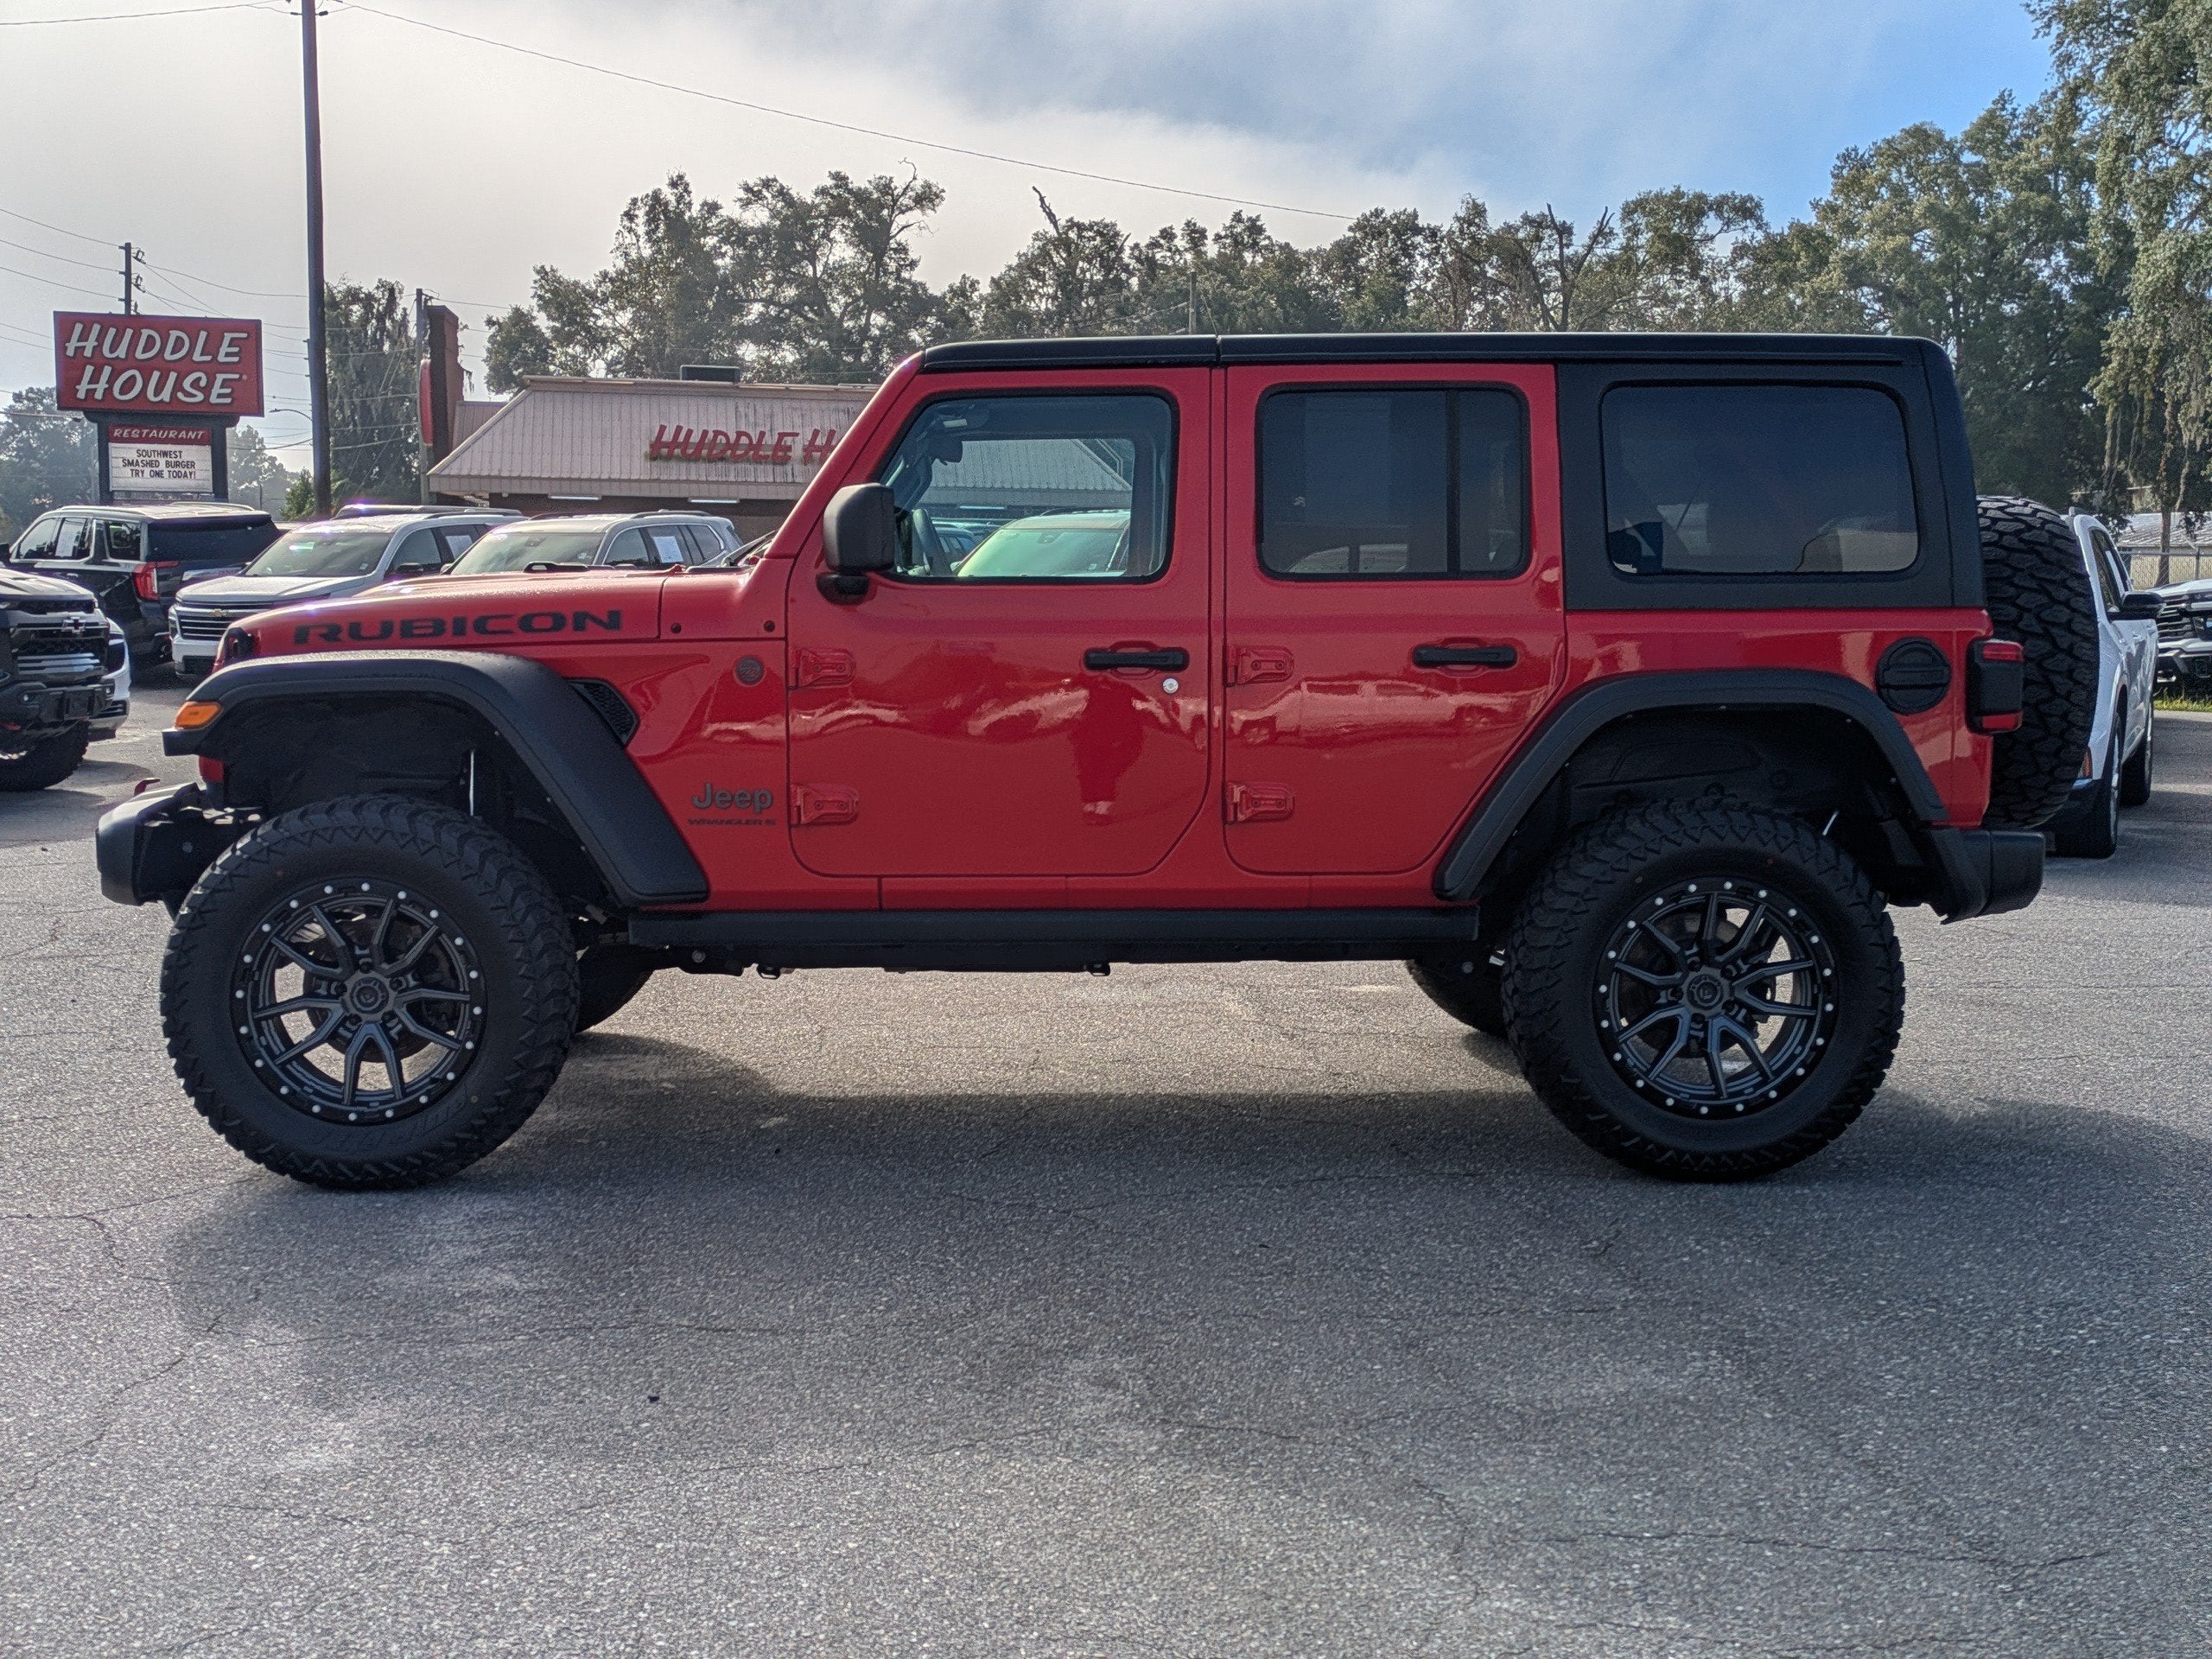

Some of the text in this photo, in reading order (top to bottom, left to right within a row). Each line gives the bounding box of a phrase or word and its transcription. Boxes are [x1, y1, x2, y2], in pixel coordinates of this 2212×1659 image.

[65, 322, 248, 363] HUDDLE
[76, 365, 240, 404] HOUSE
[113, 429, 205, 440] RESTAURANT
[649, 424, 800, 465] HUDDLE
[122, 459, 196, 469] SMASHED BURGER
[136, 449, 183, 459] SOUTHWEST
[130, 468, 196, 480] TRY ONE TODAY!
[293, 609, 622, 645] RUBICON
[692, 781, 773, 814] Jeep
